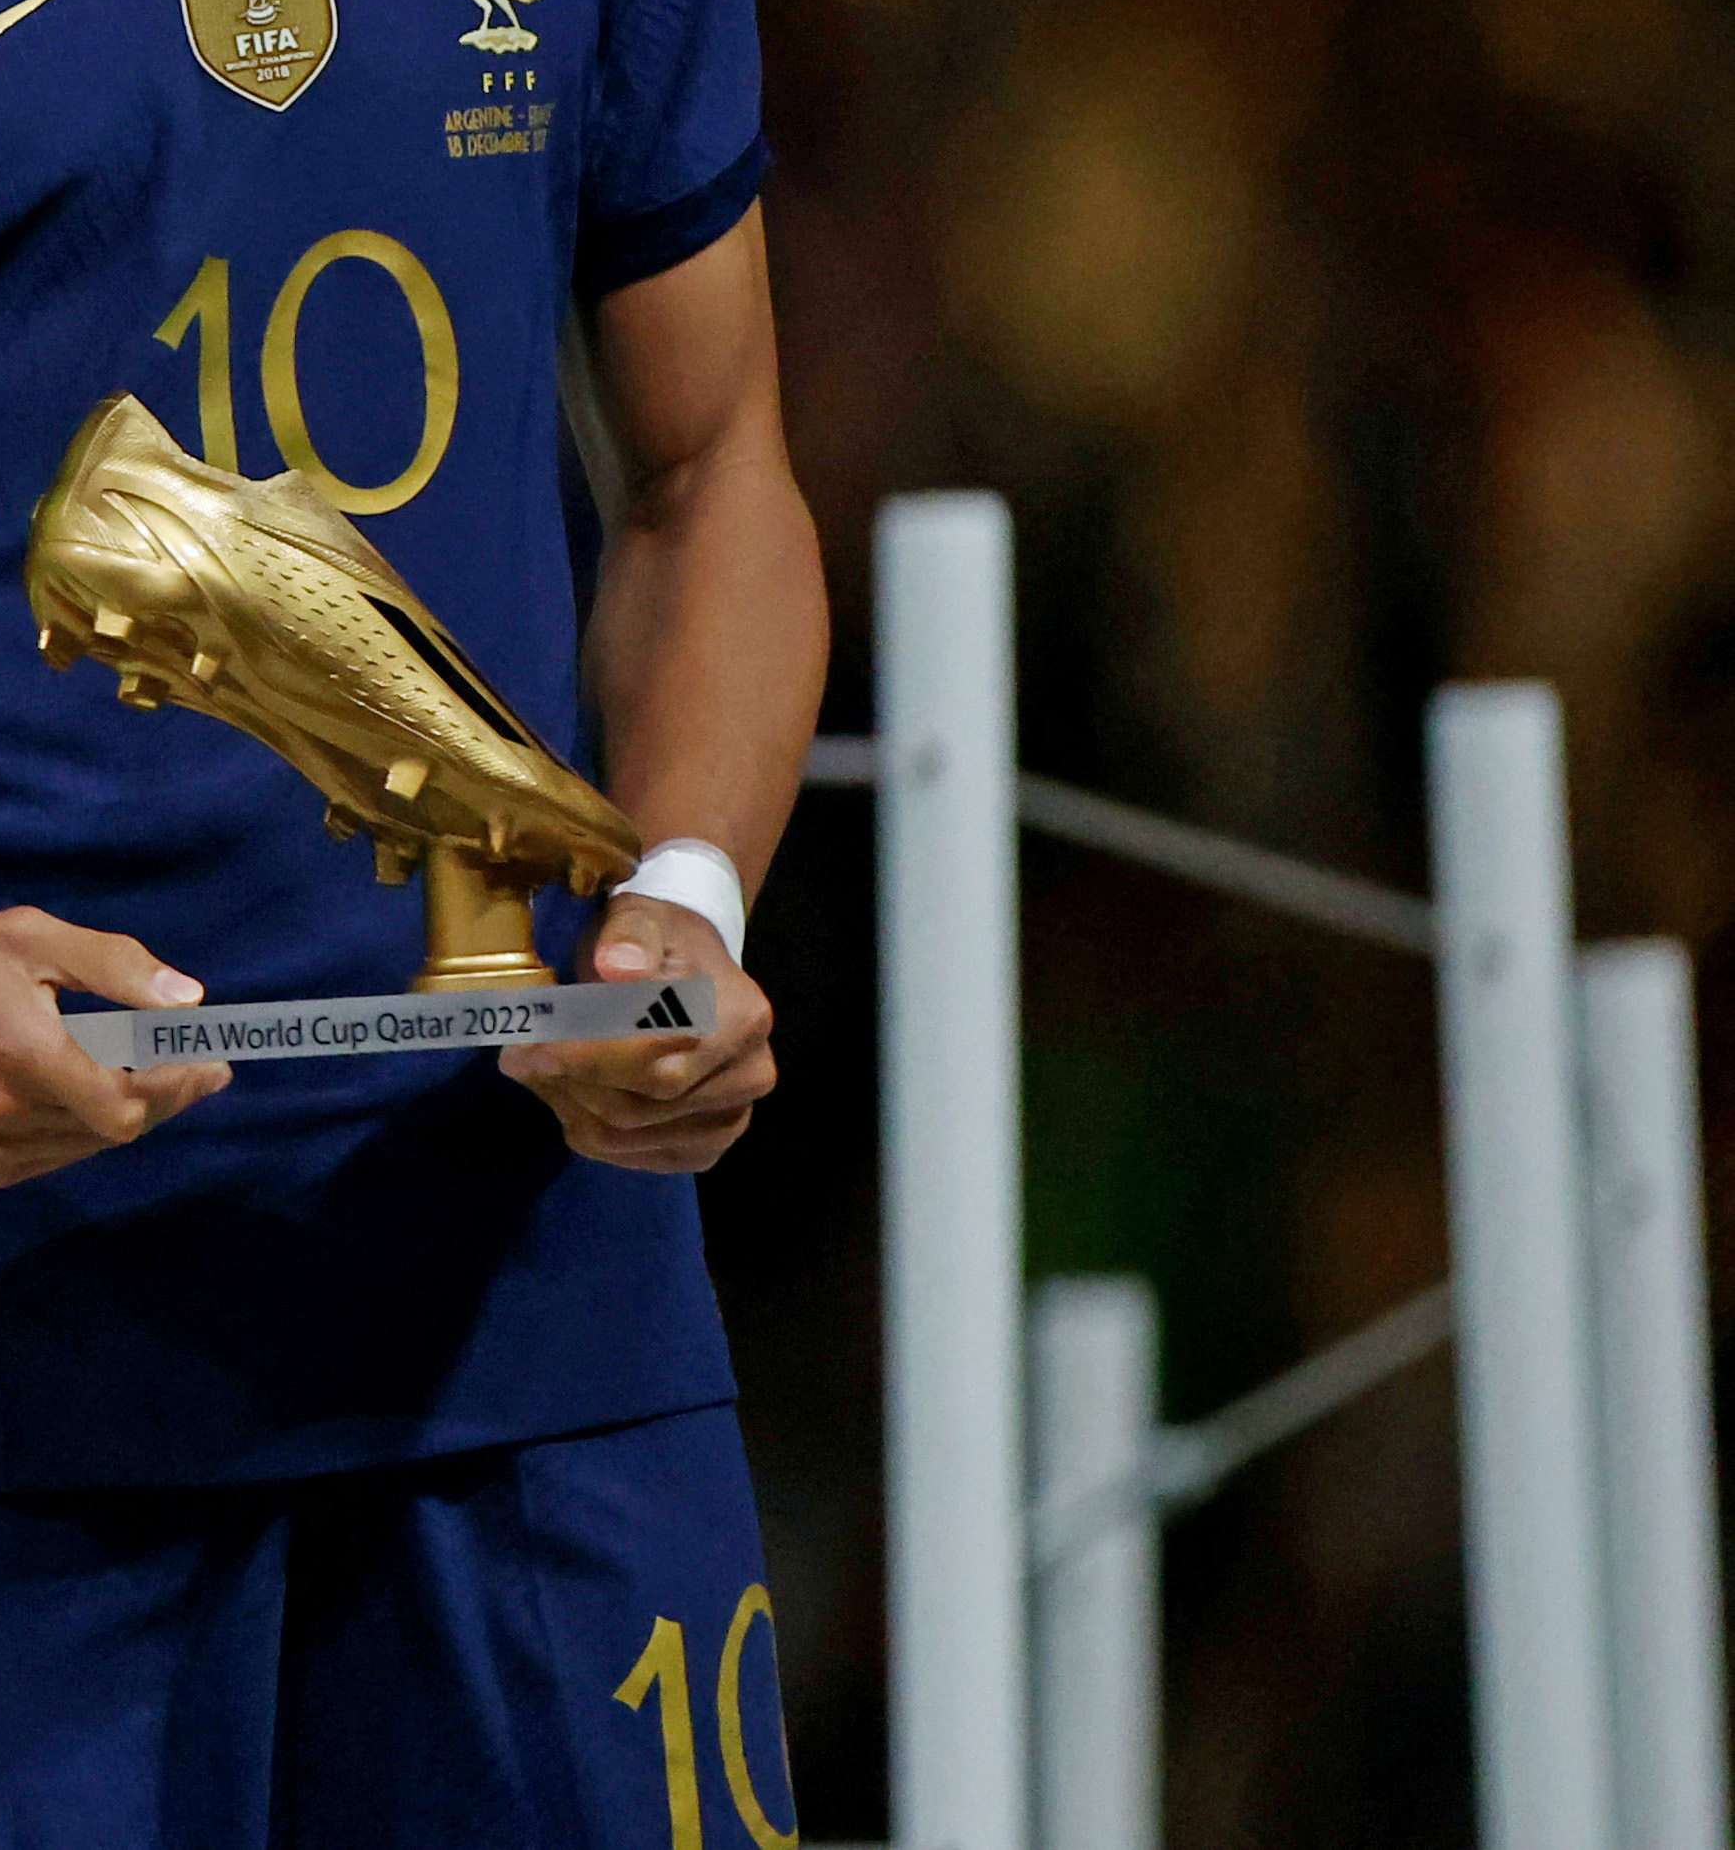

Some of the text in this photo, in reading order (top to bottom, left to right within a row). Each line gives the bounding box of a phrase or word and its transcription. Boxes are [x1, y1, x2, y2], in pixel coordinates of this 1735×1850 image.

[235, 27, 299, 58] FIFA
[257, 65, 290, 82] 2018
[153, 229, 459, 516] 10
[154, 1024, 212, 1054] FIFA
[218, 1018, 303, 1050] World
[312, 1016, 369, 1049] Cup
[376, 1012, 454, 1043] Qatar
[612, 1582, 800, 1850] 10
